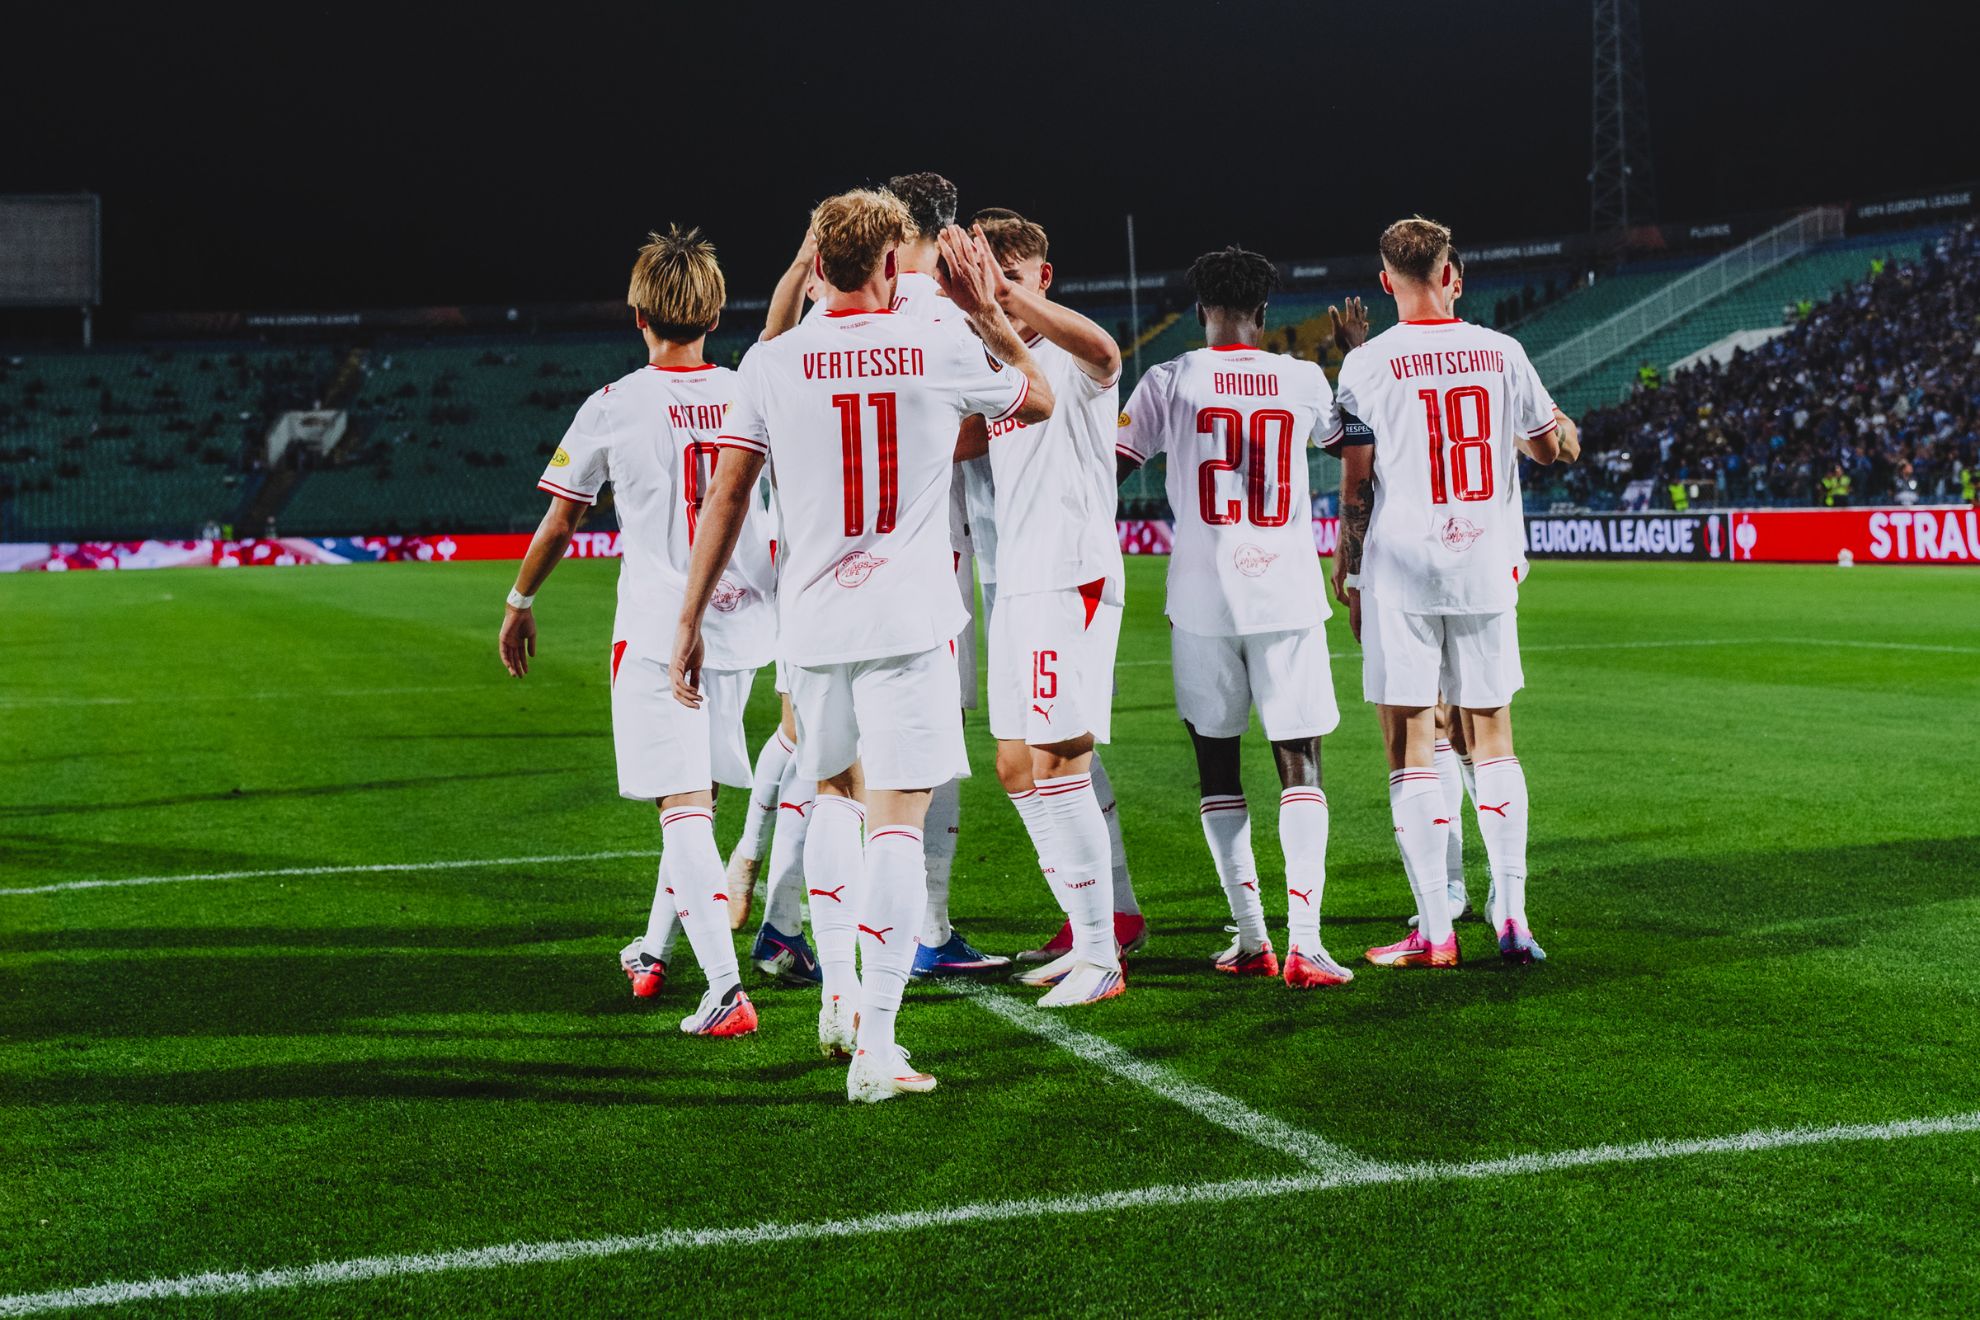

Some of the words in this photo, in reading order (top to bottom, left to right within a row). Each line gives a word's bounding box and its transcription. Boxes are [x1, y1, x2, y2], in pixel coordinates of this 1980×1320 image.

[803, 347, 924, 380] VERTESSEN
[1214, 372, 1279, 397] BAIDOO
[1390, 350, 1504, 380] VERATSCHNIG
[831, 392, 899, 537] 11
[1418, 385, 1494, 504] 18
[1197, 407, 1294, 527] 20
[1530, 519, 1607, 553] EUROPA
[1609, 519, 1695, 554] LEAGUE
[1033, 650, 1057, 699] 15
